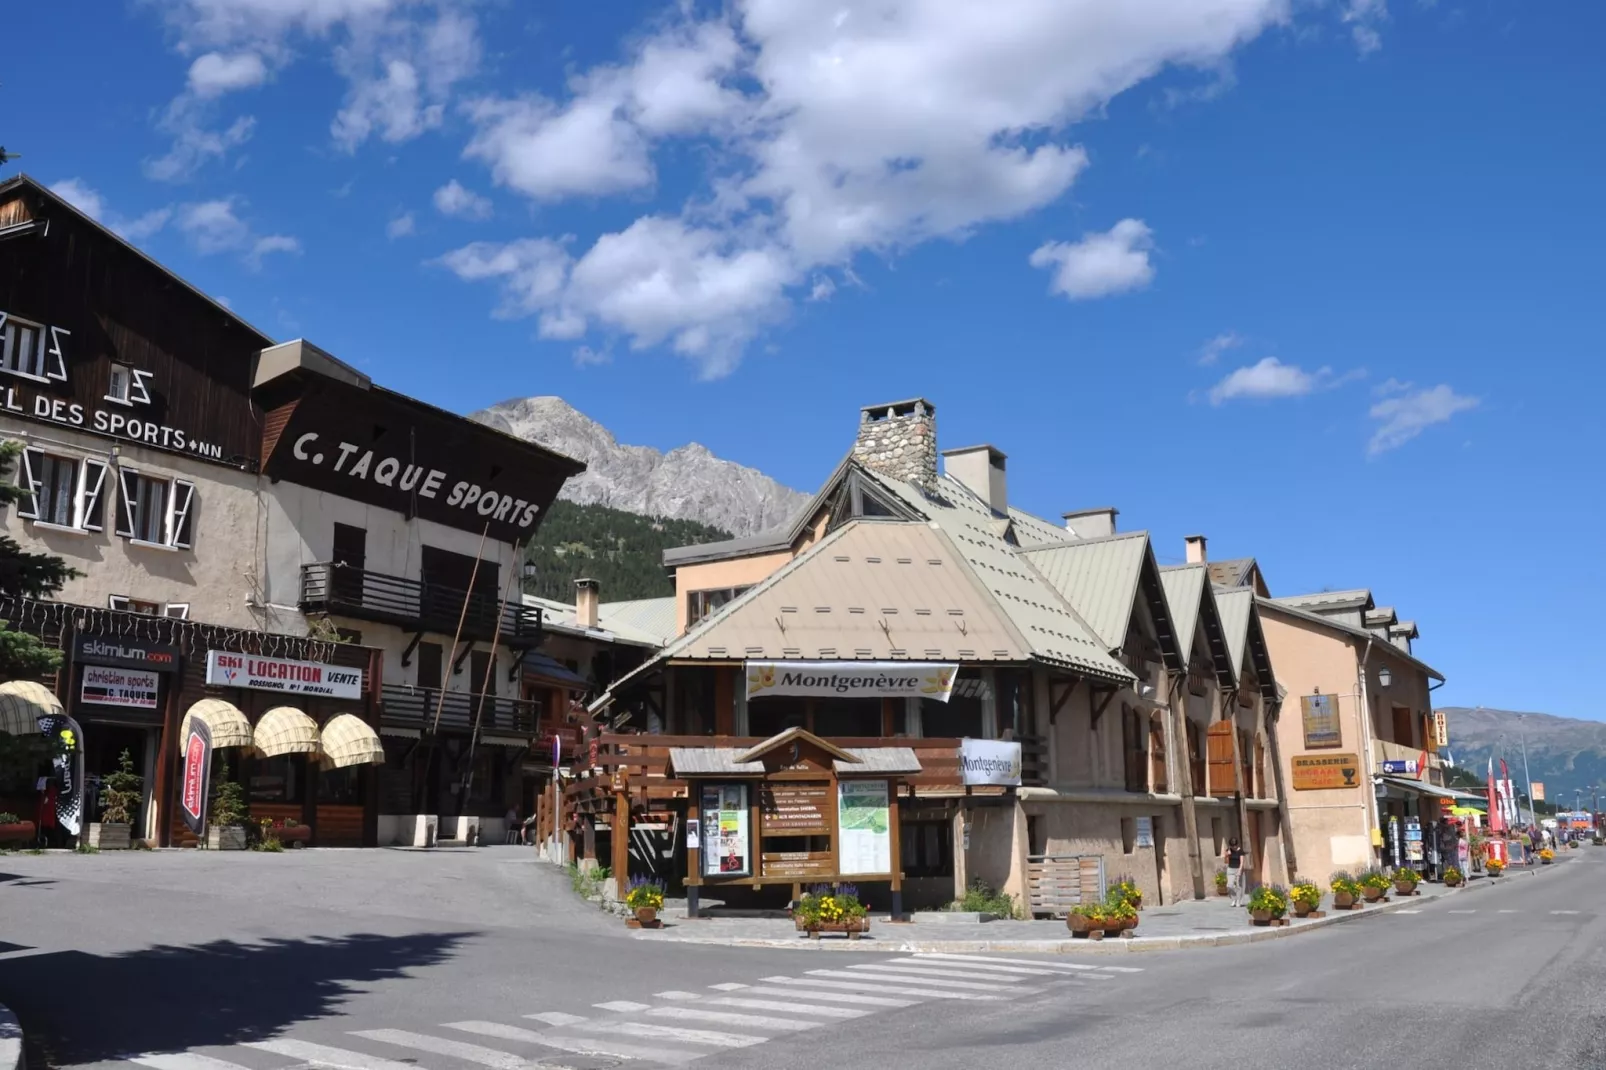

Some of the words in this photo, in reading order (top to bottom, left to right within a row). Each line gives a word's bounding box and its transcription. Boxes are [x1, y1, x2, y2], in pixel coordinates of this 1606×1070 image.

[0, 385, 23, 411] L
[34, 395, 84, 424] DES
[93, 410, 186, 450] SPORTS
[293, 432, 324, 465] C.
[333, 441, 447, 498] TAQUE
[446, 480, 540, 528] SPORTS
[83, 640, 172, 663] skimium.com
[87, 669, 125, 685] christian
[127, 675, 154, 689] sports
[217, 655, 243, 668] SKI
[247, 660, 322, 683] LOCATION
[327, 671, 359, 685] VENTE
[248, 679, 285, 689] ROSSIGNOL
[303, 685, 334, 695] MONDIAL
[780, 672, 919, 693] Montgenèvre
[119, 690, 146, 699] TAQUE
[1296, 758, 1349, 766] BRASSERIE
